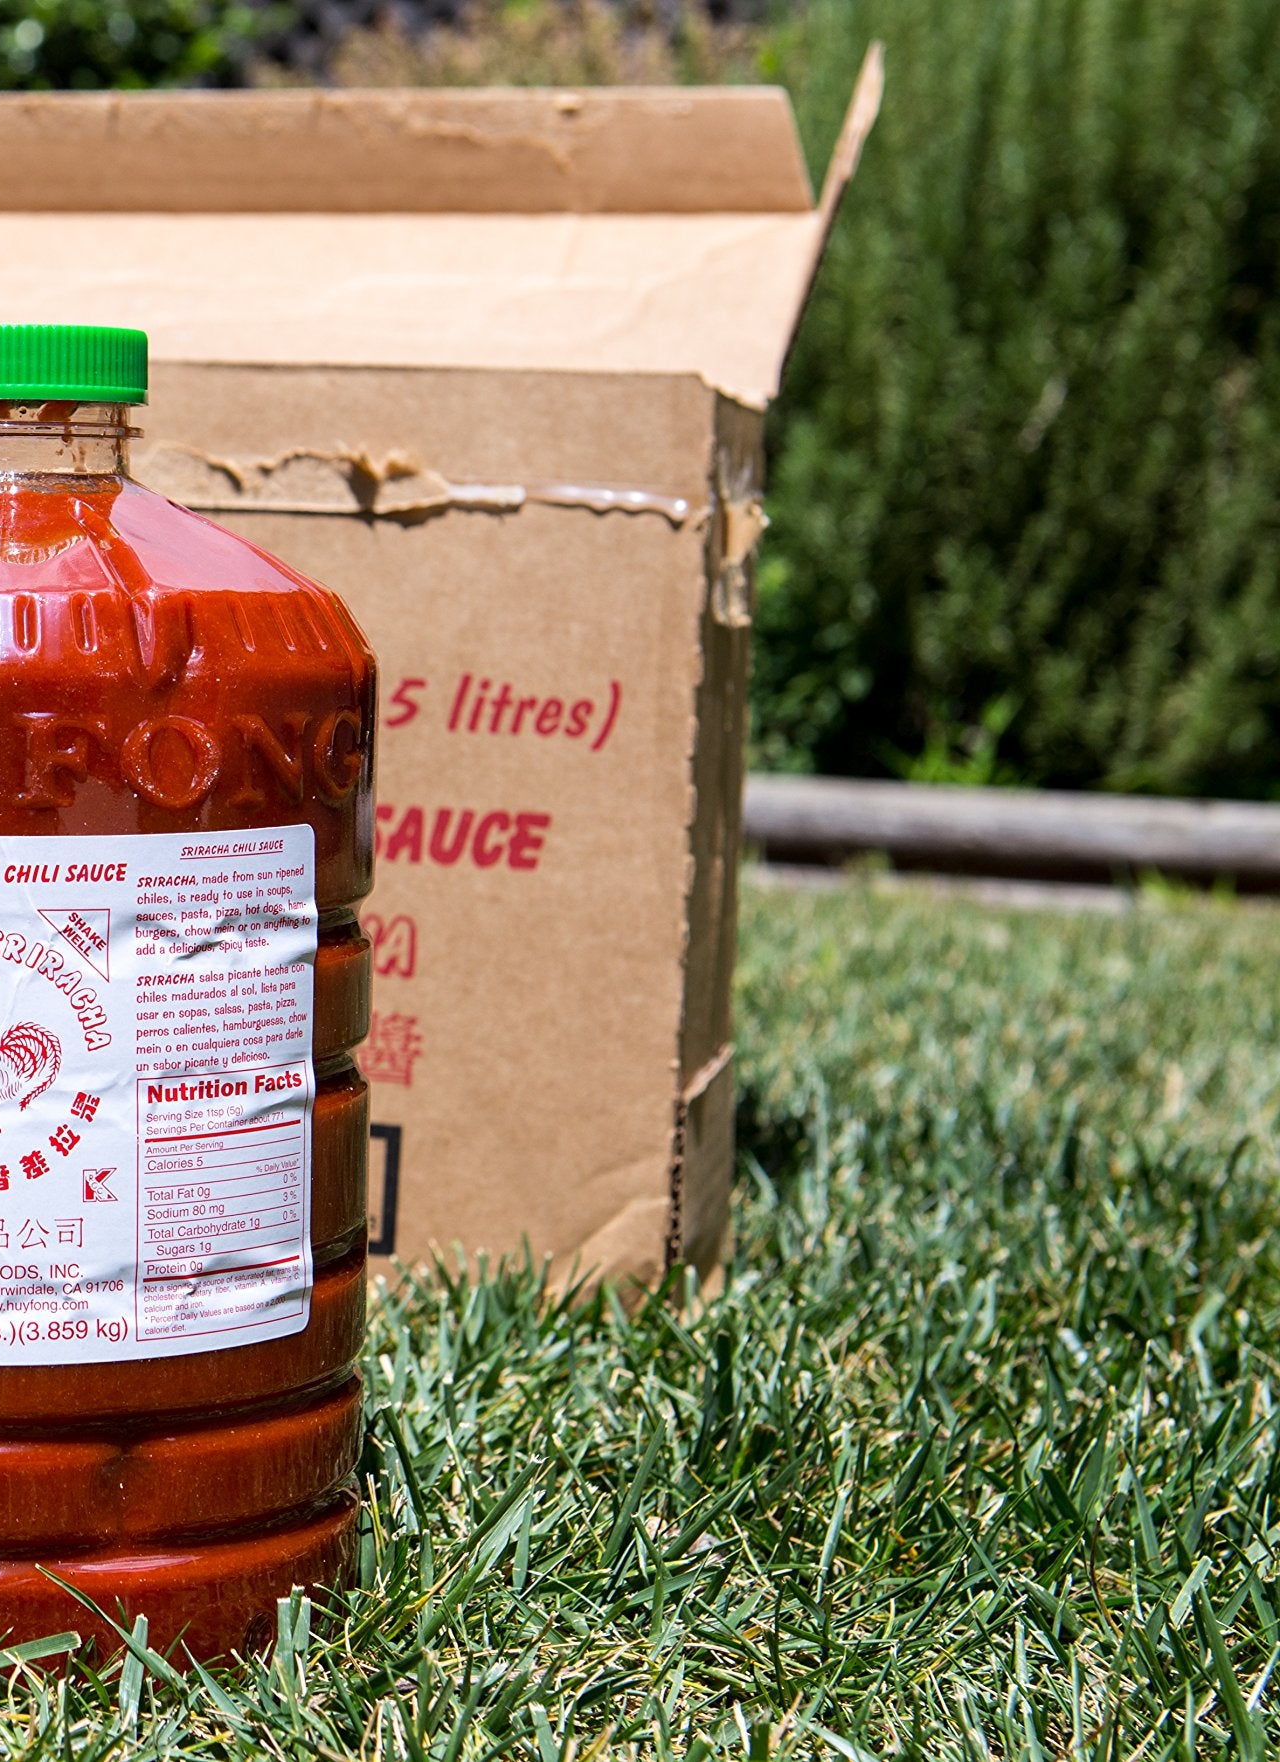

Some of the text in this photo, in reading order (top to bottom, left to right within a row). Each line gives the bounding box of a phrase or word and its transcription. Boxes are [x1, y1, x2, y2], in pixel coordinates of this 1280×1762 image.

[448, 673, 622, 751] litres)
[19, 711, 365, 810] FONG
[181, 840, 284, 856] SRIRACHA CHILI SAUCE
[5, 865, 60, 883] CHILI
[65, 863, 127, 883] SAUCE
[137, 864, 304, 888] SRIRACHA, made from sun ripened
[137, 885, 293, 905] chiles, is ready to use in soups,
[136, 911, 177, 921] sauces,
[181, 909, 211, 922] pasta,
[216, 907, 242, 921] pizza,
[246, 904, 260, 915] hot
[263, 902, 285, 915] dogs,
[63, 926, 91, 957] WELL
[68, 912, 107, 951] SHAKE
[136, 937, 269, 955] add a delicious, spicy taste.
[137, 963, 305, 987] SRIRACHA salsa picante hecha con
[148, 1071, 302, 1103] Nutrition Facts
[148, 1157, 203, 1171] Calories 5
[147, 1186, 211, 1201] Total Fat 0g
[147, 1203, 225, 1219] Sodium 80 mg
[148, 1217, 260, 1239] Total Carbohydrate 1g
[156, 1242, 212, 1257] Sugars 1g
[50, 1264, 83, 1279] INC.
[147, 1261, 203, 1275] Protein 0g
[63, 1283, 82, 1294] CA
[86, 1280, 124, 1294] 91706
[96, 1317, 128, 1342] kg)
